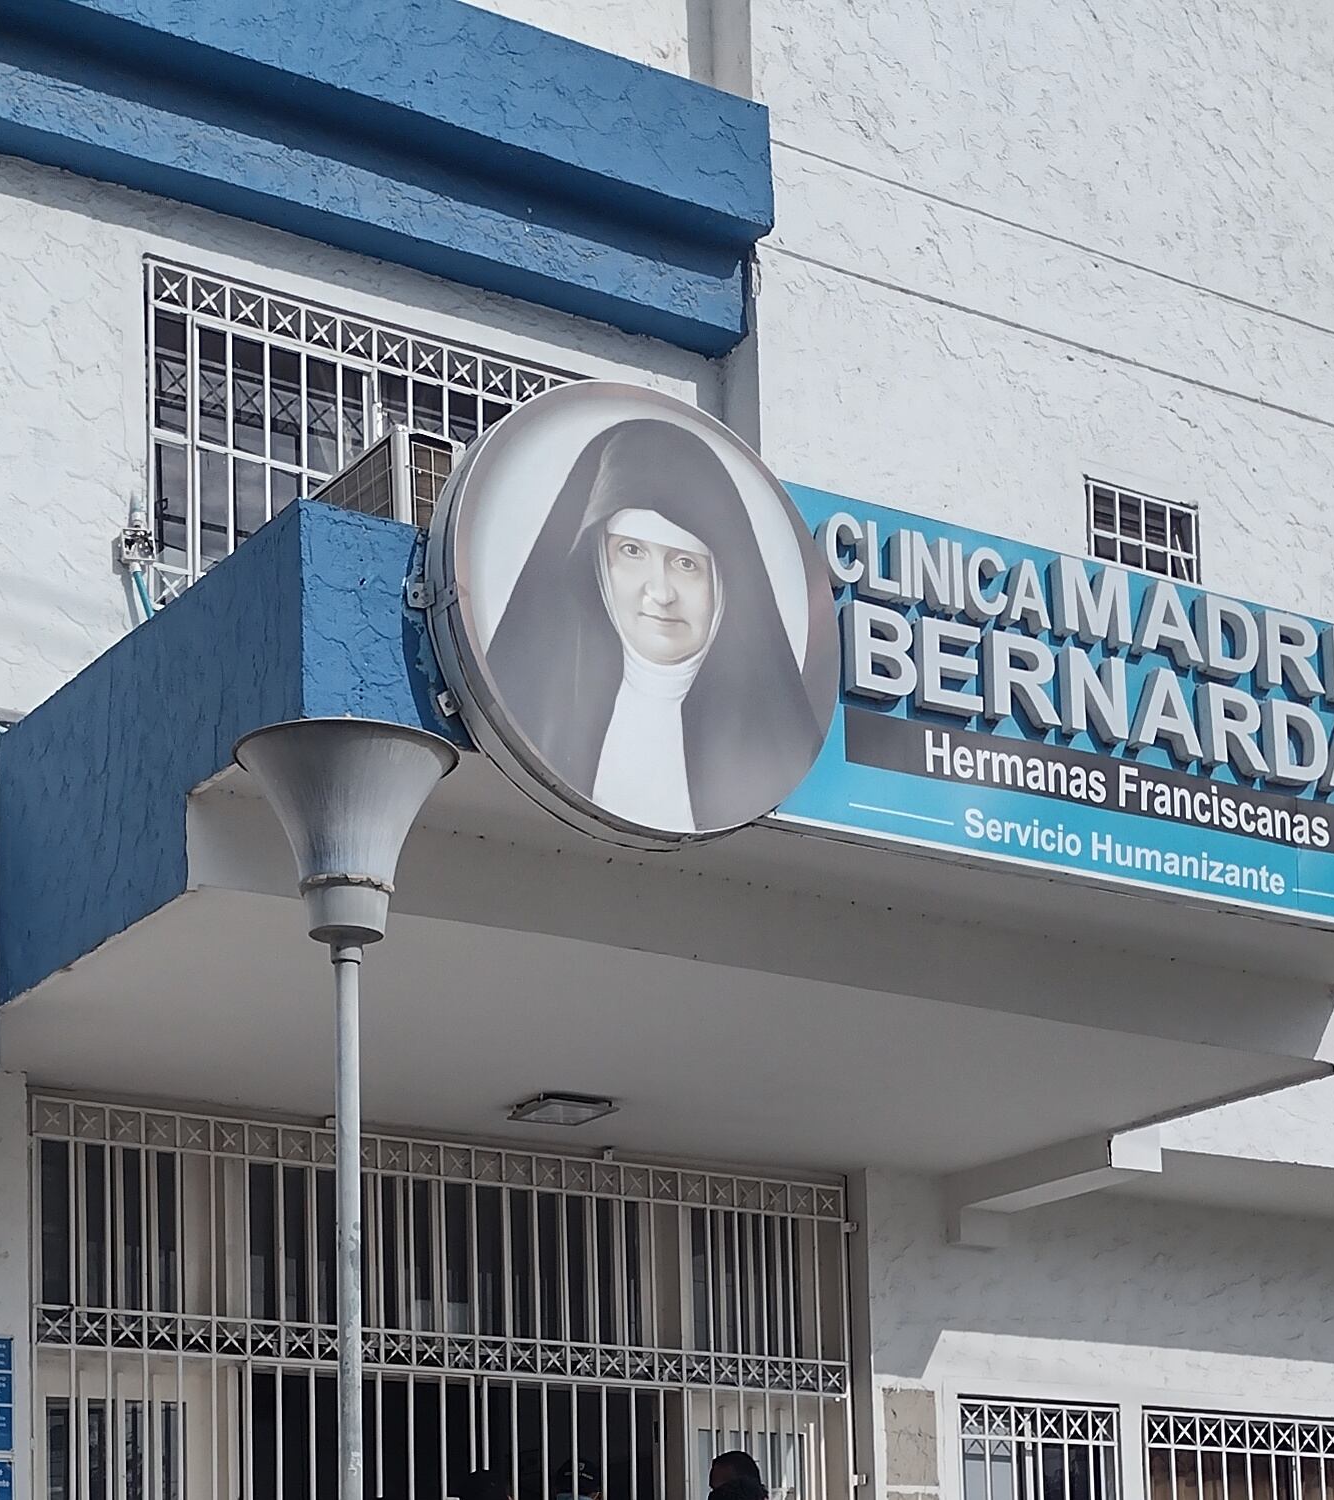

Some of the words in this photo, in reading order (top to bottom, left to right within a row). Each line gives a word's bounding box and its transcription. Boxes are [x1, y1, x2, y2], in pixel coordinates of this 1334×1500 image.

[823, 511, 1056, 636] CLINICA
[924, 730, 1107, 802] Hermanas
[1118, 765, 1330, 848] Franciscanas
[964, 807, 1082, 858] Servicio
[1091, 832, 1285, 896] Humanizante
